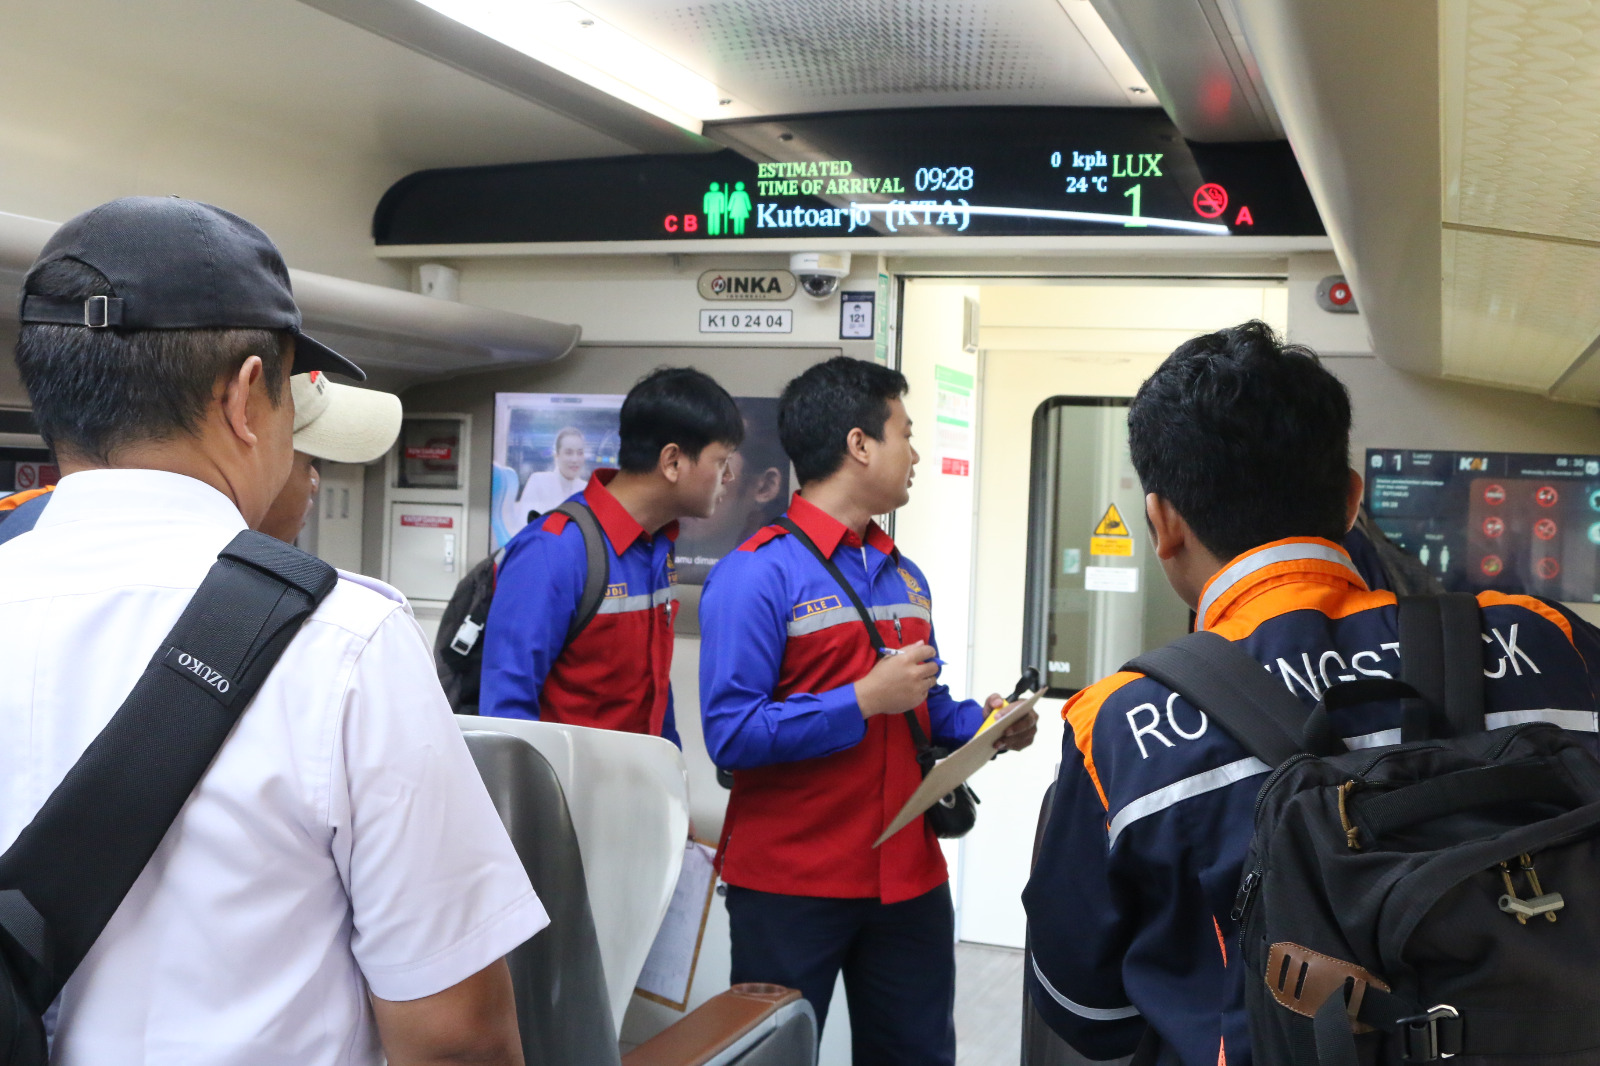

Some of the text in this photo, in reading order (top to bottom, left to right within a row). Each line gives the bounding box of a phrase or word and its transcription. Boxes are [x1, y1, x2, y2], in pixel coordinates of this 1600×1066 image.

[757, 160, 853, 179] ESTIMATED
[1050, 150, 1108, 171] 0 kph
[1111, 153, 1164, 178] LUX
[757, 177, 906, 197] TIME OF ARRIVAL
[914, 166, 974, 192] 09:28
[1123, 183, 1149, 228] 1
[664, 214, 699, 232] C B
[756, 202, 872, 233] Kutoarjo
[1235, 206, 1254, 226] A
[727, 277, 782, 293] INKA
[744, 315, 761, 328] 24
[766, 315, 783, 328] 04
[849, 313, 865, 323] 121
[675, 556, 693, 564] amu
[806, 600, 828, 614] ALE
[178, 653, 230, 693] OZUKO
